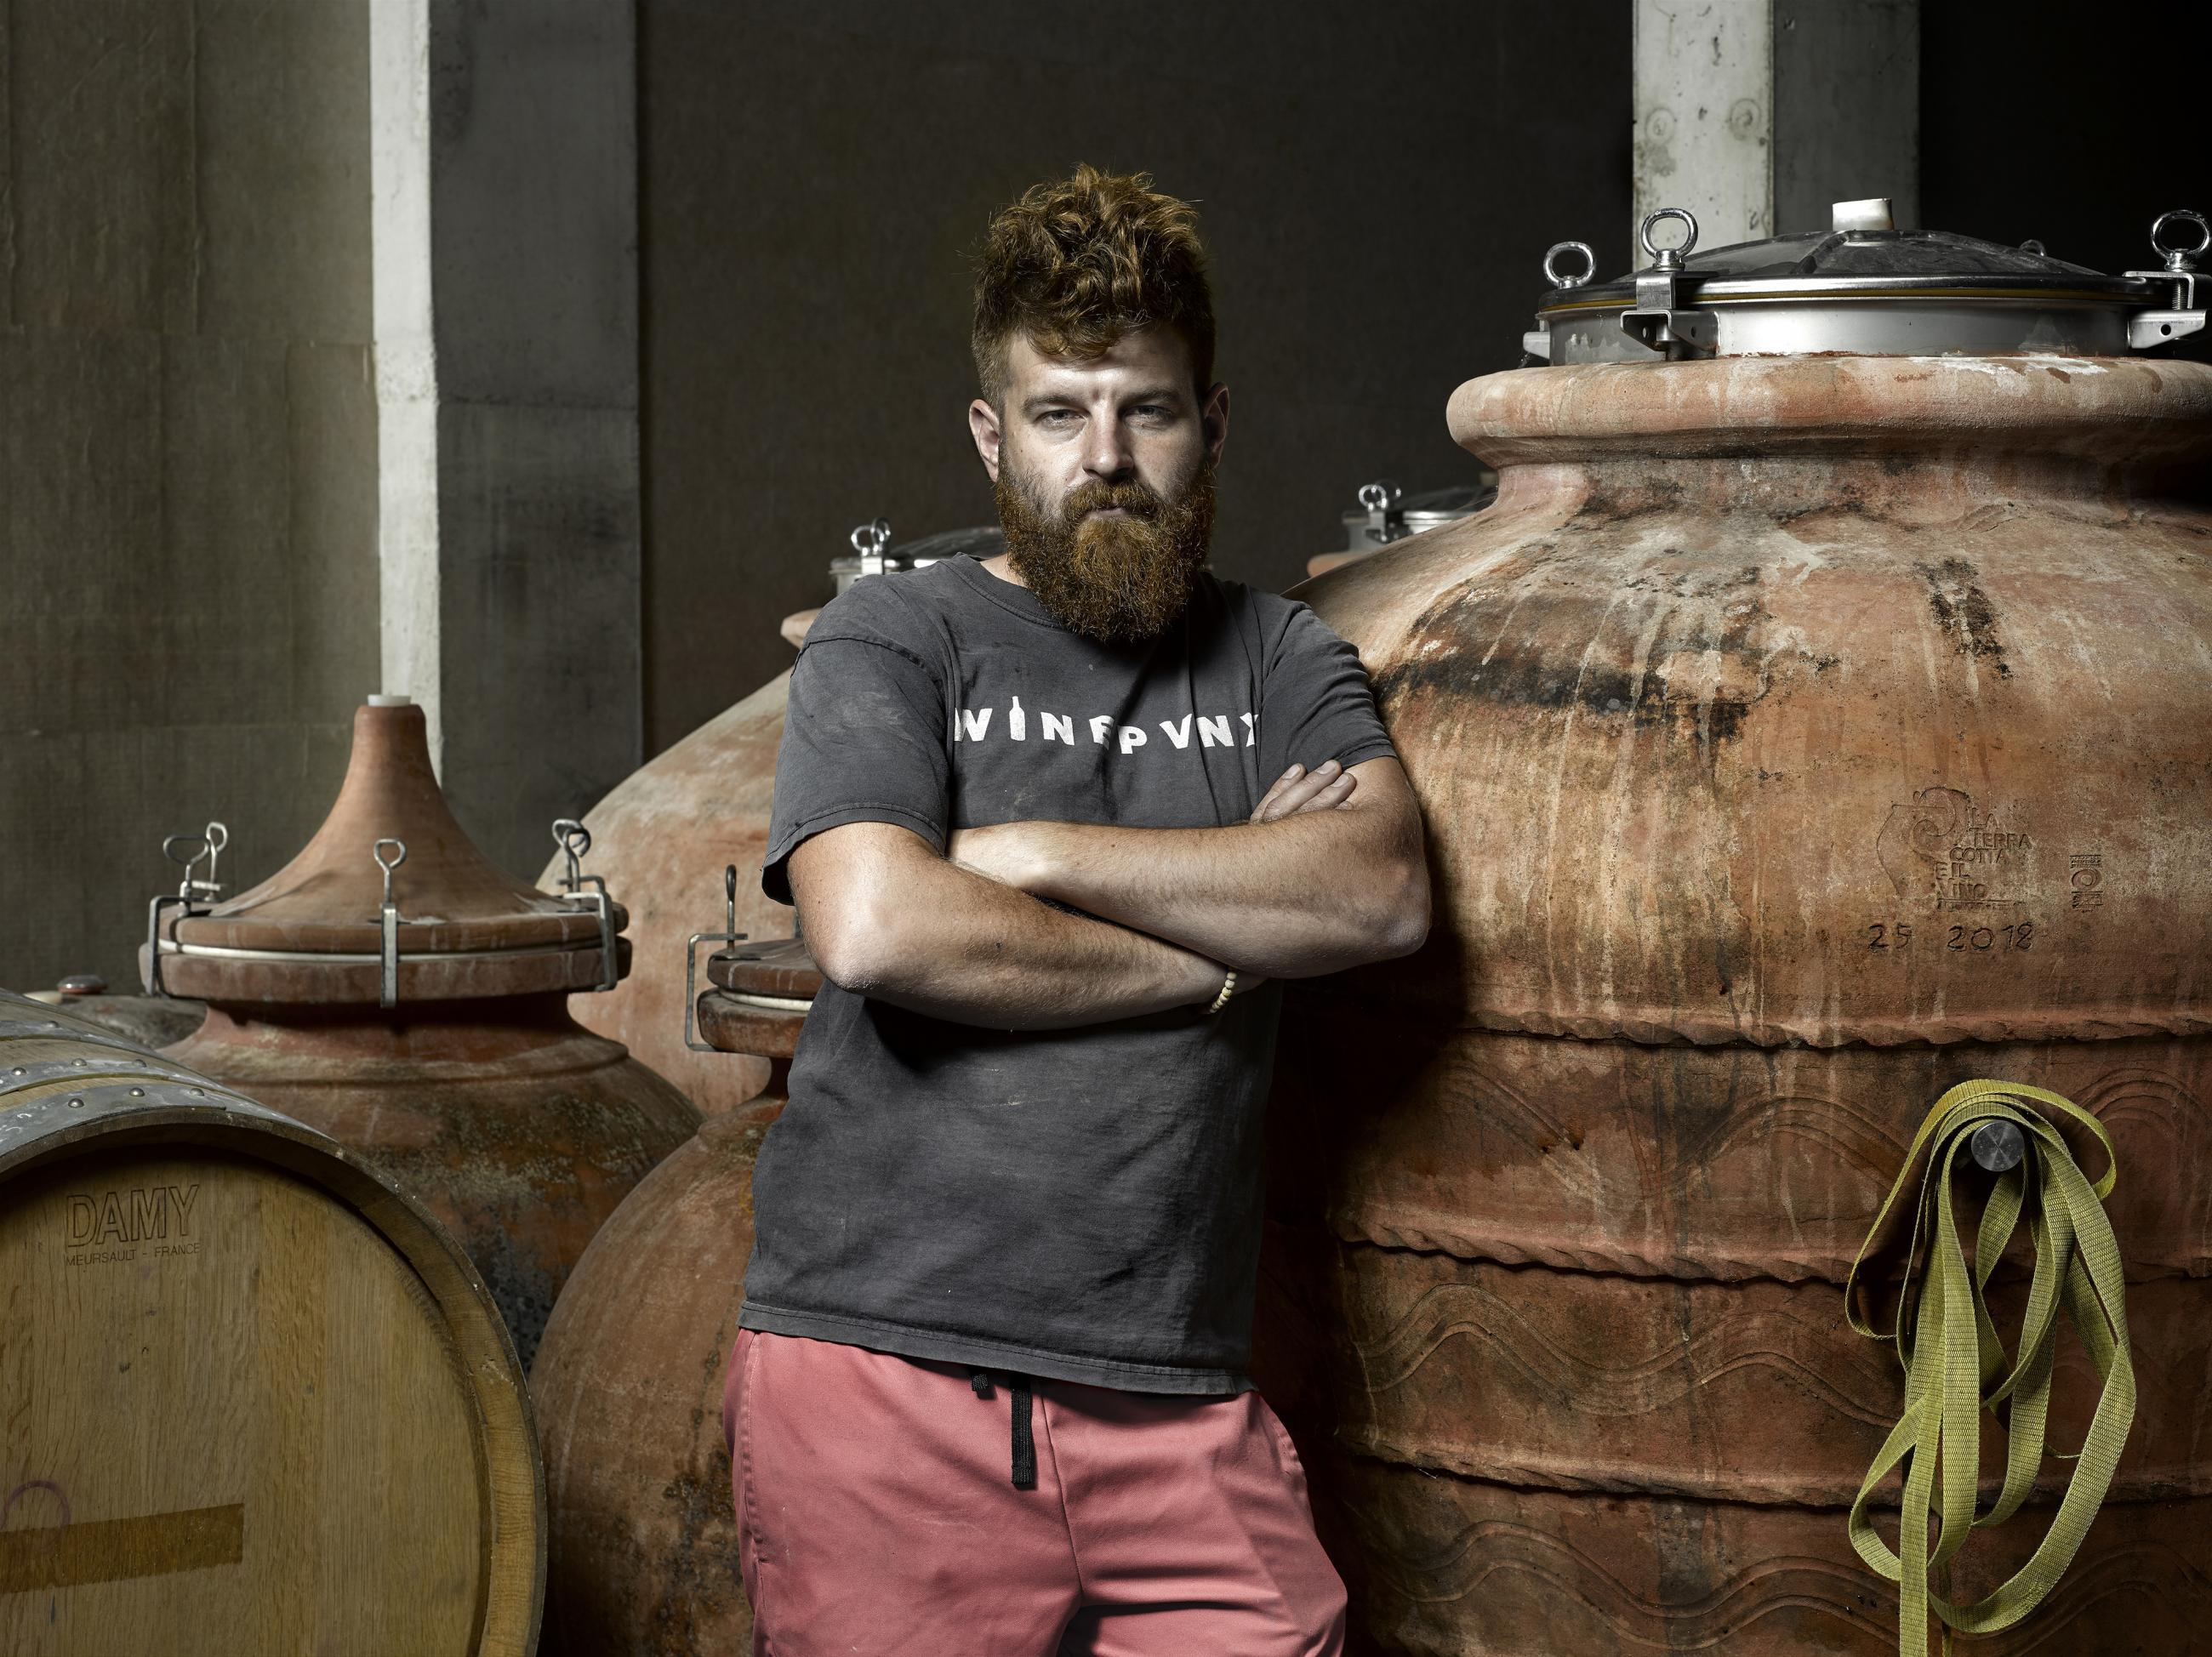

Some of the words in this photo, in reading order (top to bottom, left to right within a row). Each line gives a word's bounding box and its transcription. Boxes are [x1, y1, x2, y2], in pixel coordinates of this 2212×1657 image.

[1974, 833, 2032, 850] TERRA
[66, 1184, 200, 1248] DAMY
[66, 1250, 137, 1267] MEURSAULT
[154, 1243, 201, 1258] FRANCE
